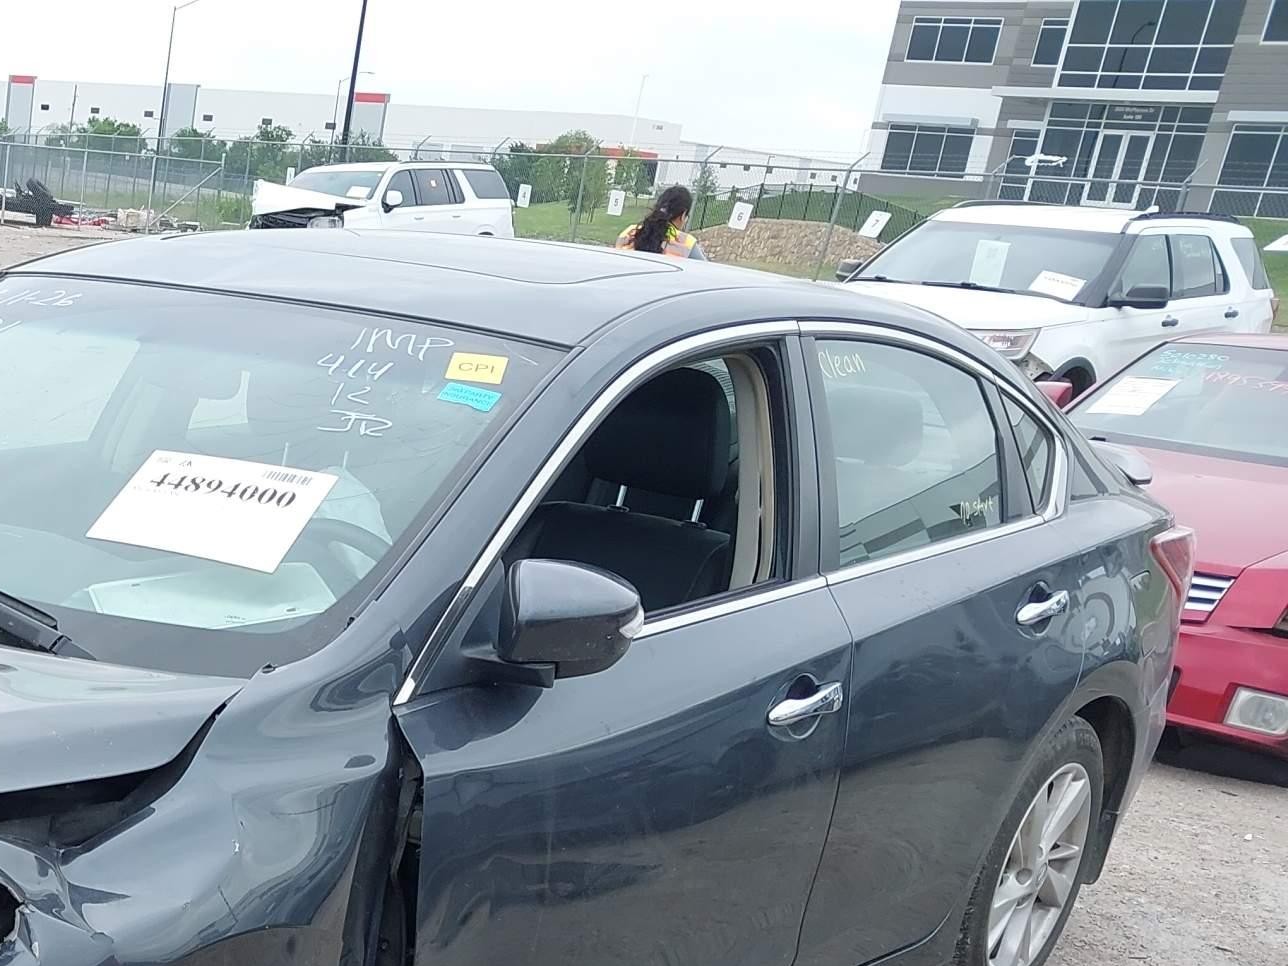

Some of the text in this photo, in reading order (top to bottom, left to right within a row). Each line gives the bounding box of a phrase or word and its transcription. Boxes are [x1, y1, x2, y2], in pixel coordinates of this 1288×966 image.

[736, 211, 745, 222] 6
[871, 218, 880, 229] 7
[457, 361, 496, 375] CPI
[817, 348, 867, 381] Clean
[330, 382, 372, 406] 12
[149, 472, 298, 508] 44894000
